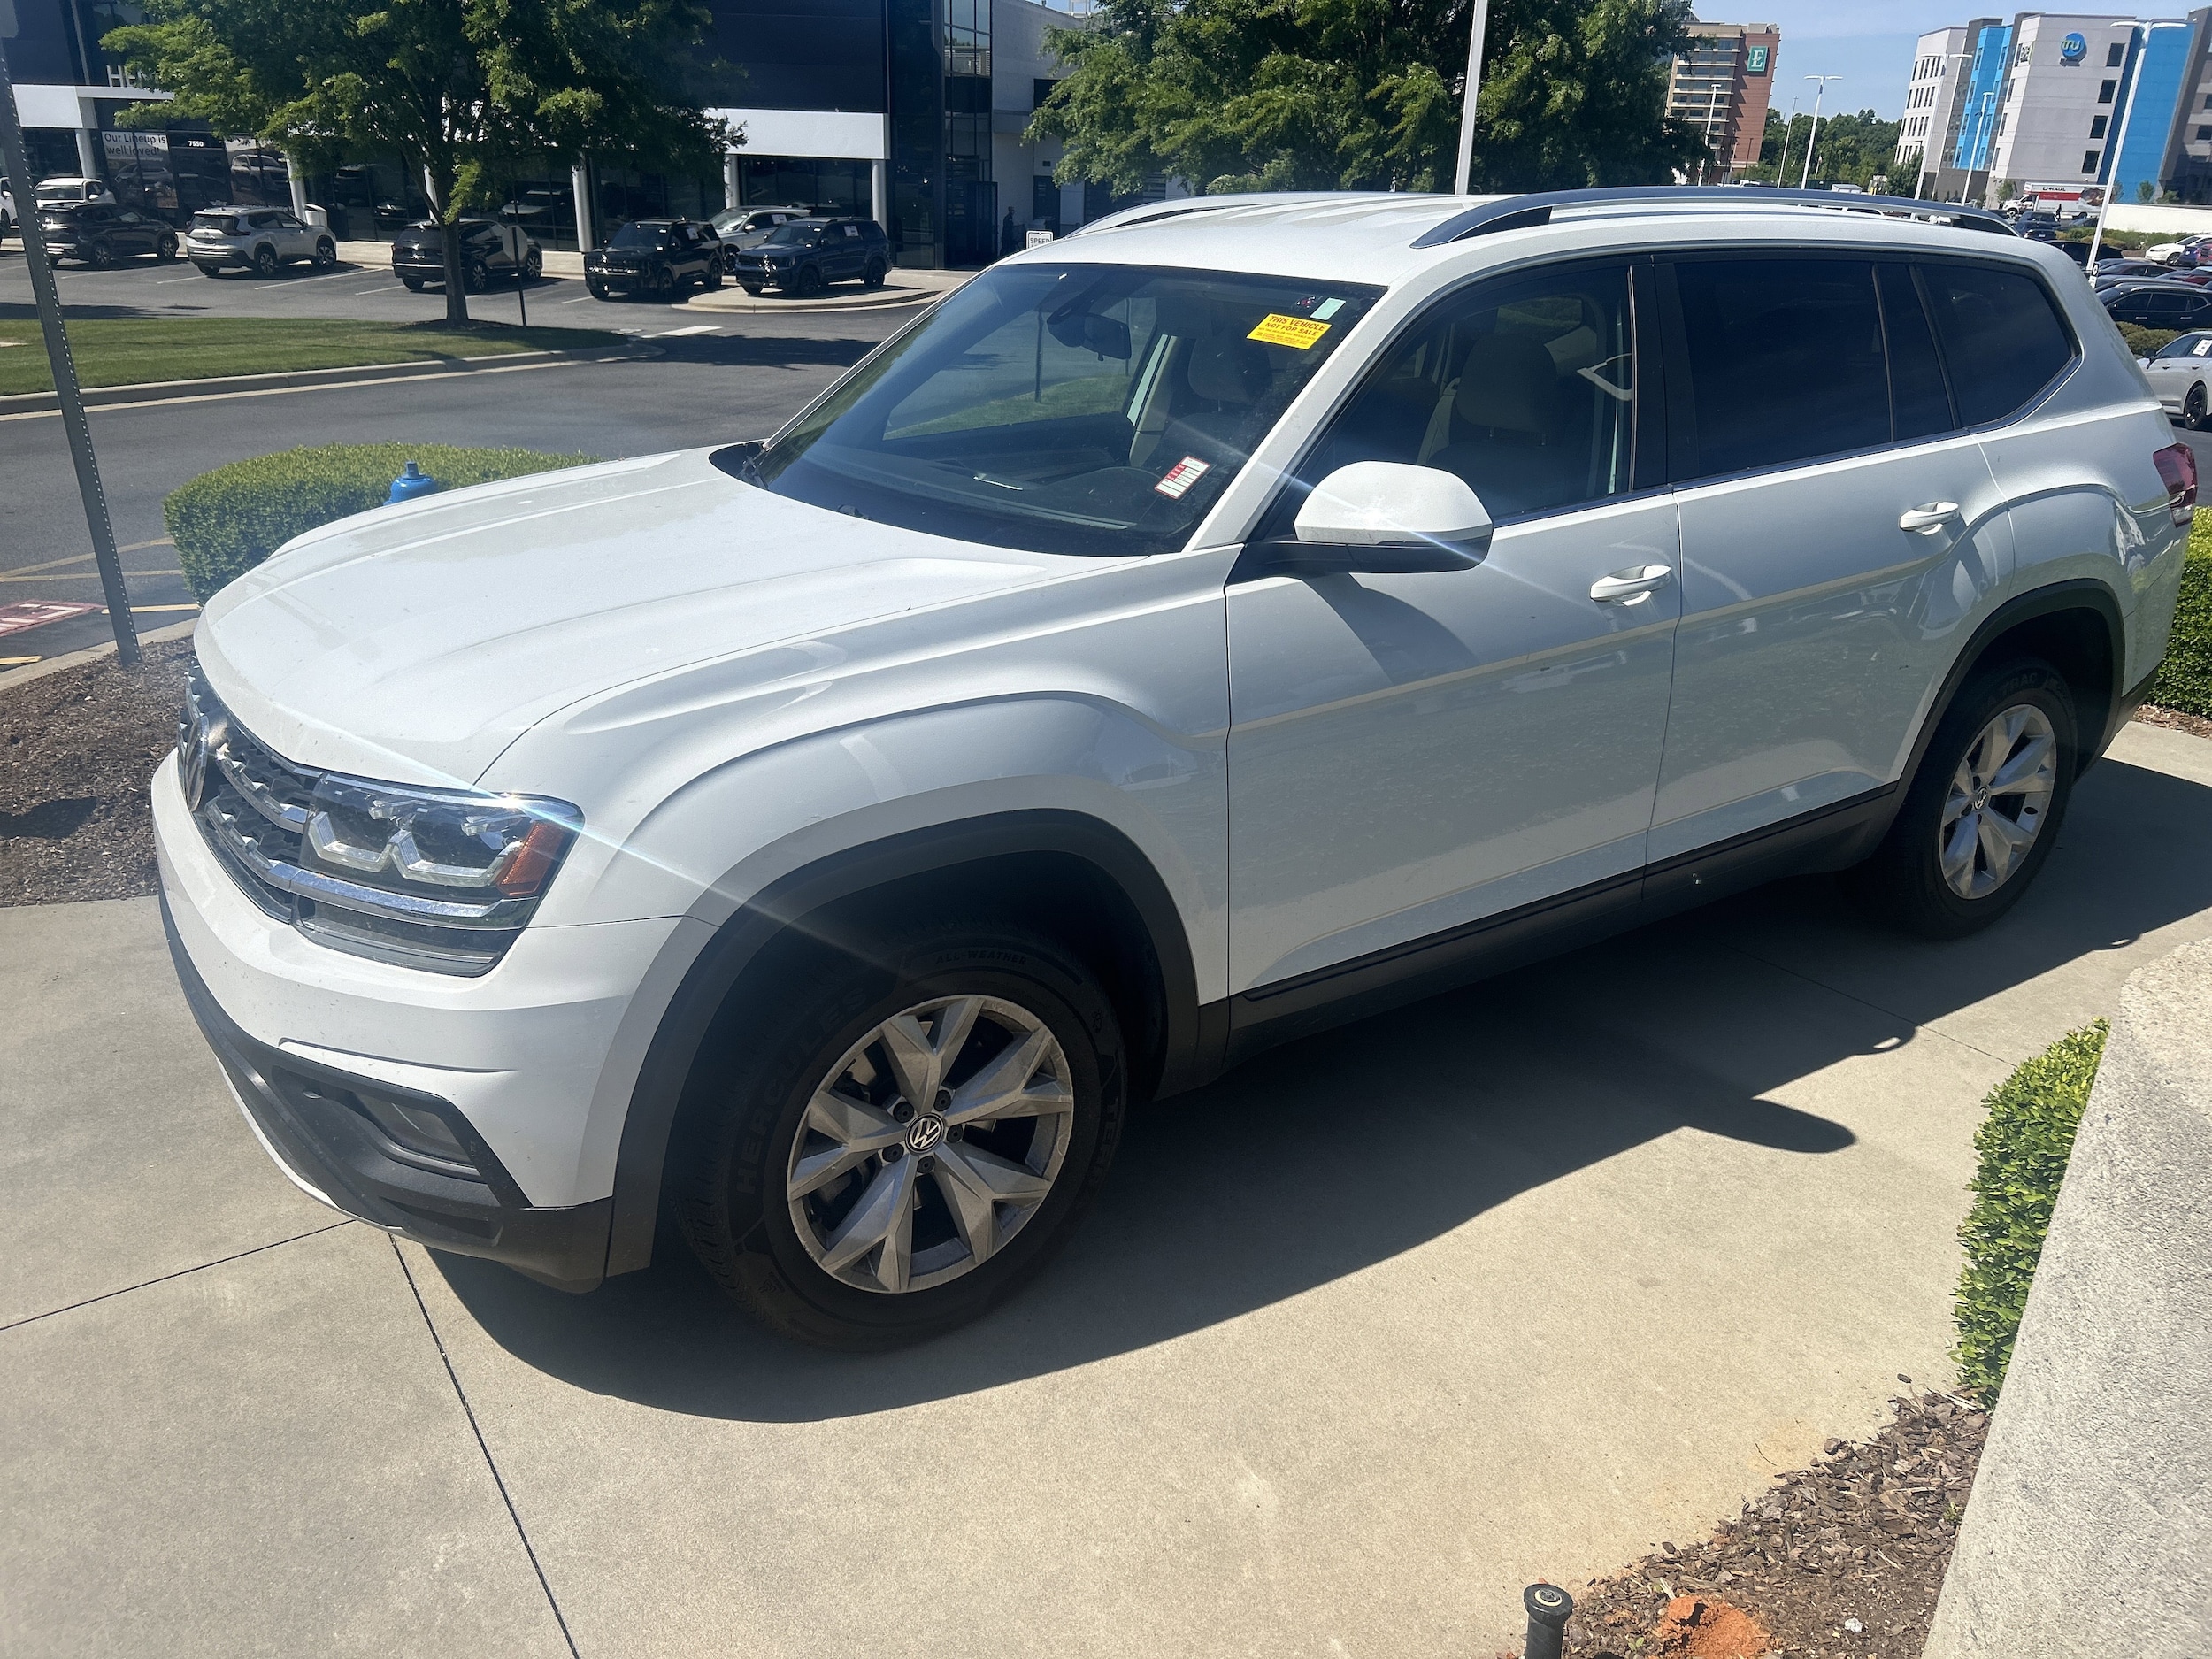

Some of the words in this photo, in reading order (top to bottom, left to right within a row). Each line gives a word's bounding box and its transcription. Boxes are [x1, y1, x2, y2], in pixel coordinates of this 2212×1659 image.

[2062, 40, 2080, 50] tru
[1751, 50, 1764, 68] E
[104, 134, 121, 142] Our
[124, 134, 157, 145] Lineup
[157, 134, 167, 144] is
[107, 145, 127, 155] well
[1290, 319, 1327, 331] VEHICLE
[935, 950, 1027, 965] ALL-WEATHER
[736, 987, 867, 1194] HERCULES
